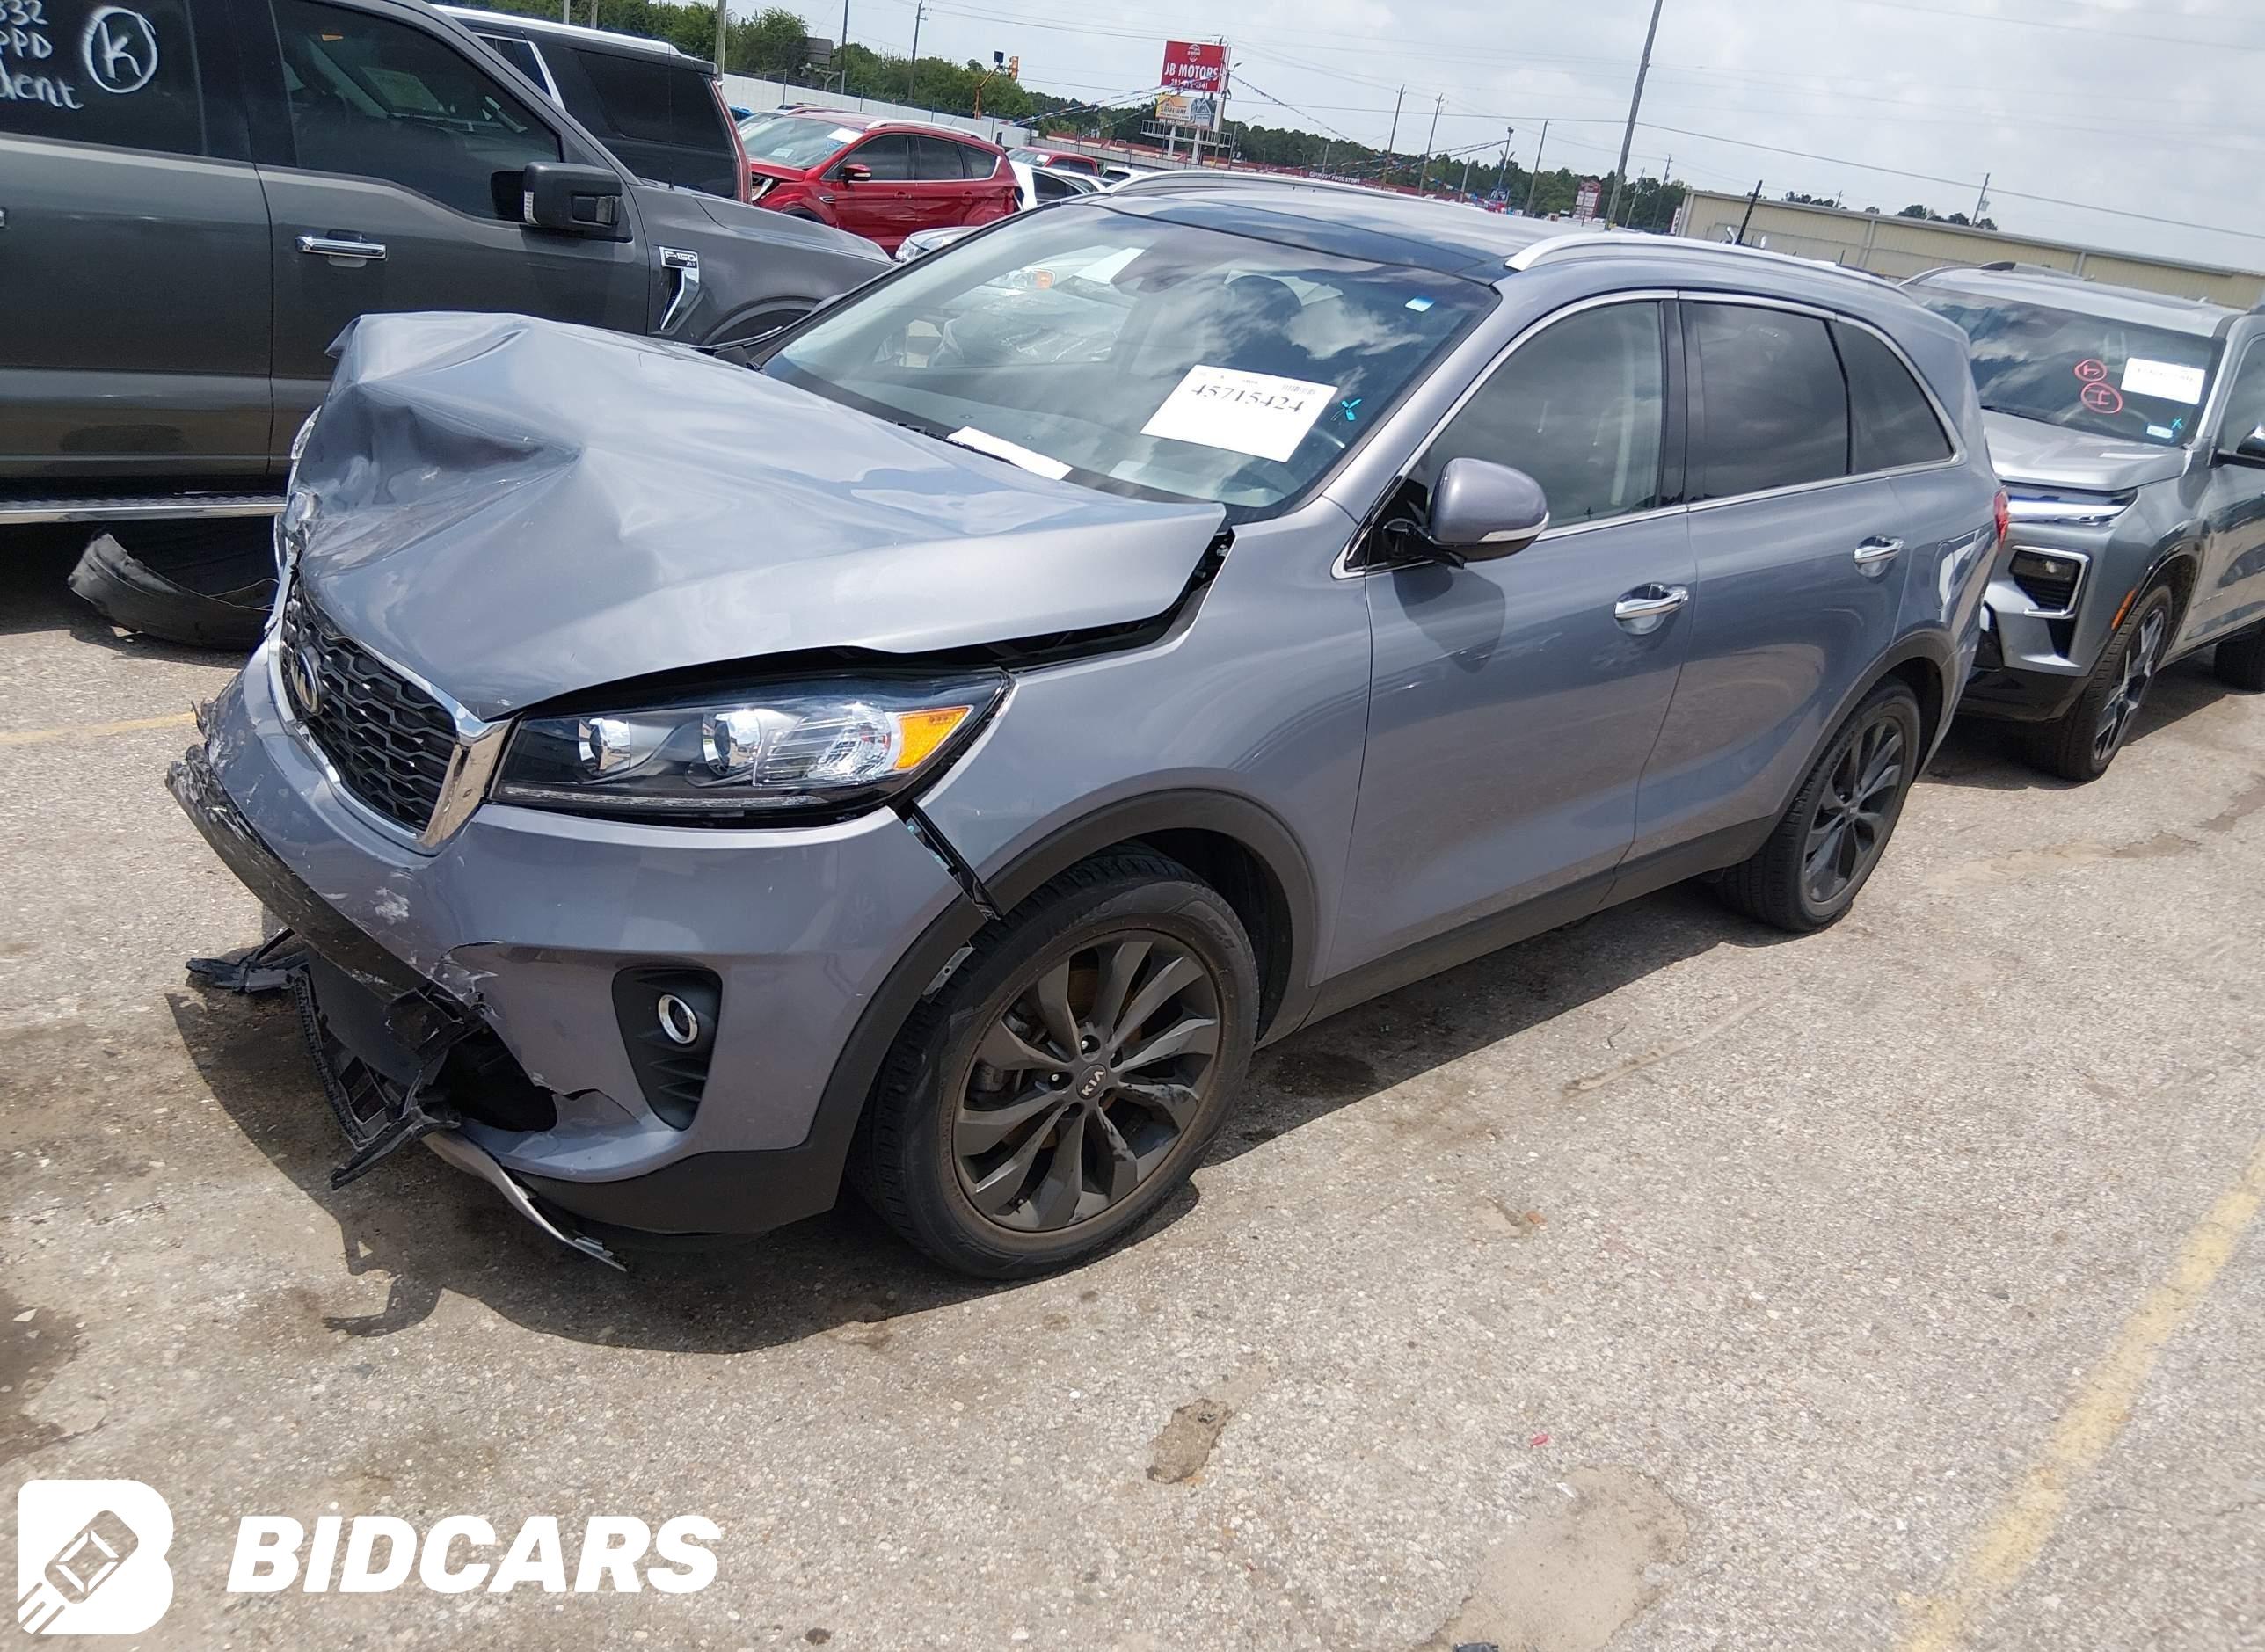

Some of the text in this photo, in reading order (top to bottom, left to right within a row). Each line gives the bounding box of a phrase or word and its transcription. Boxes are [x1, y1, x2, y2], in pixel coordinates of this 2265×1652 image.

[1164, 62, 1219, 81] JB MOTORS
[1191, 383, 1305, 412] 45715424
[1082, 1071, 1105, 1095] KIA
